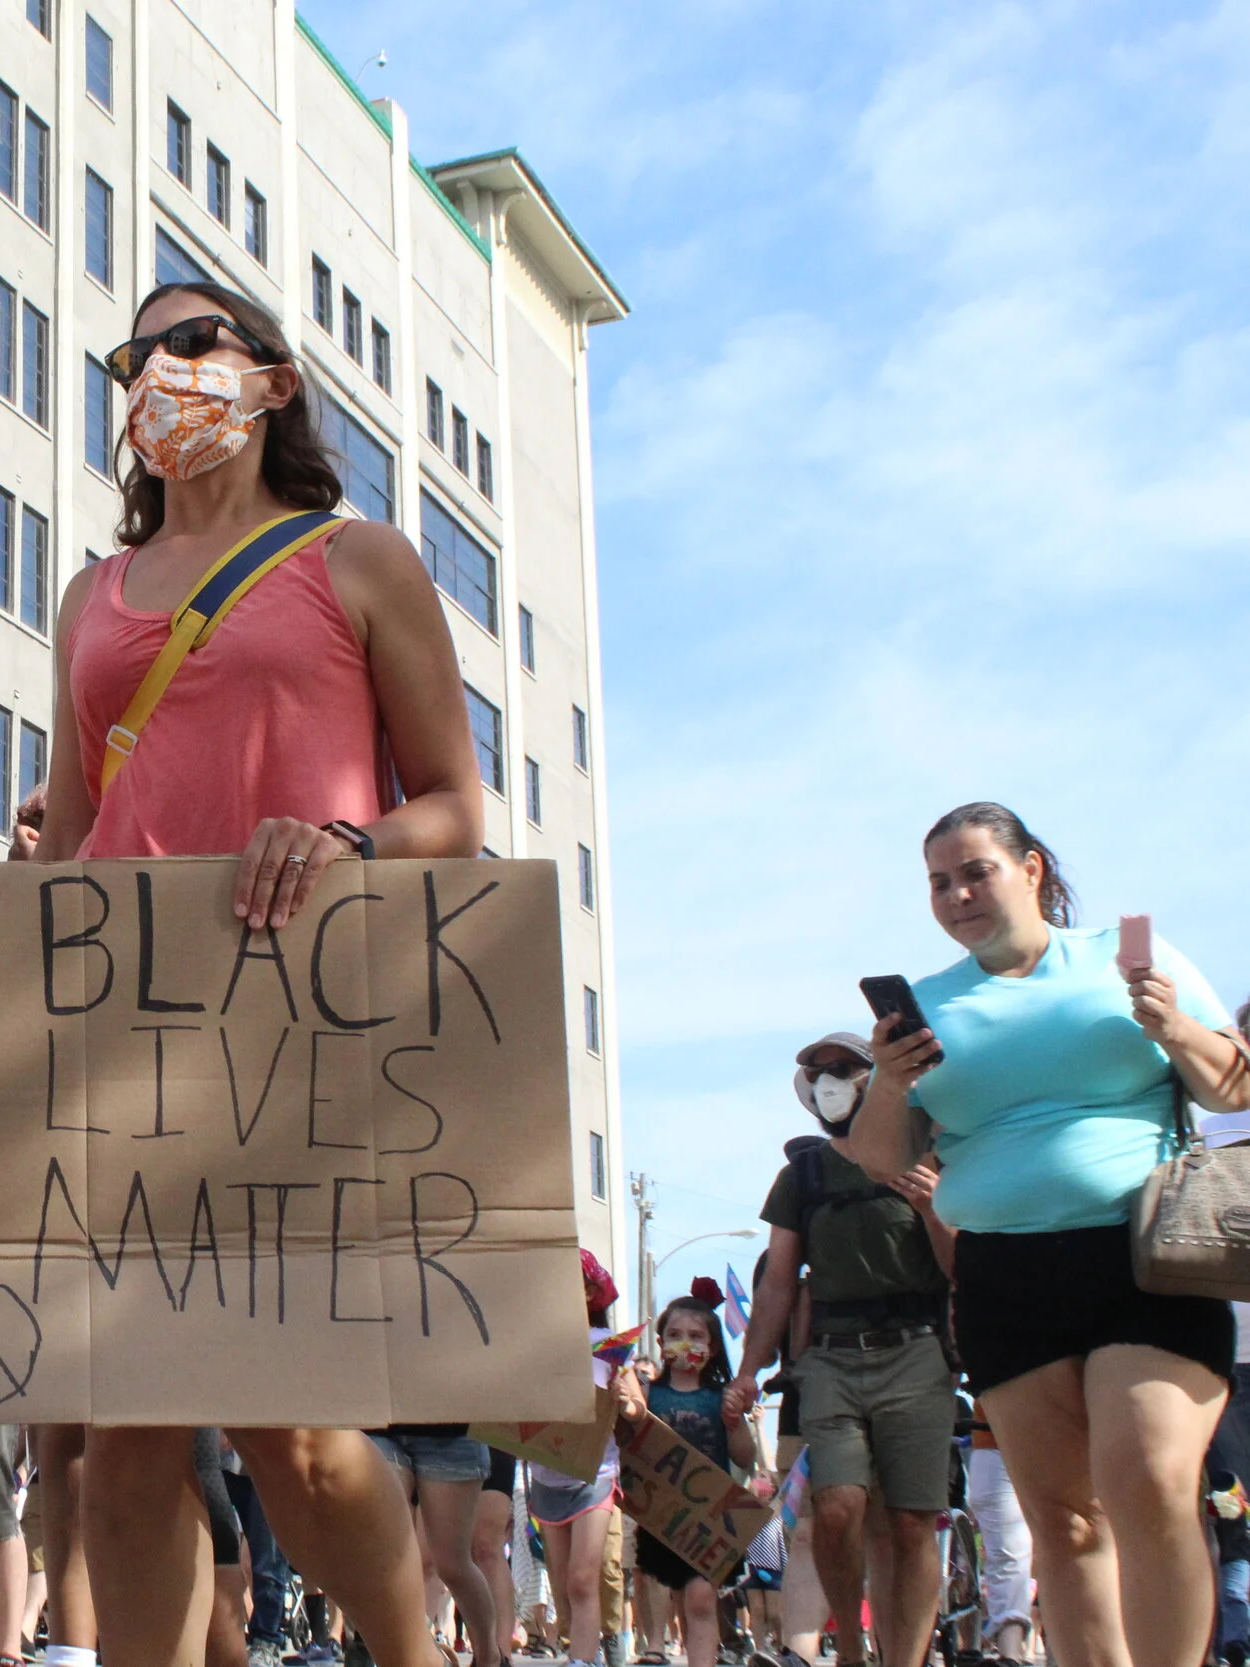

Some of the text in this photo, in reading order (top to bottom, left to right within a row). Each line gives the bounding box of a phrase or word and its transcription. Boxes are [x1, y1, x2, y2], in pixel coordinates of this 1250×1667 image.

[40, 870, 501, 1045] BLACK
[47, 1026, 443, 1155] LIVES
[33, 1156, 490, 1346] MATTER
